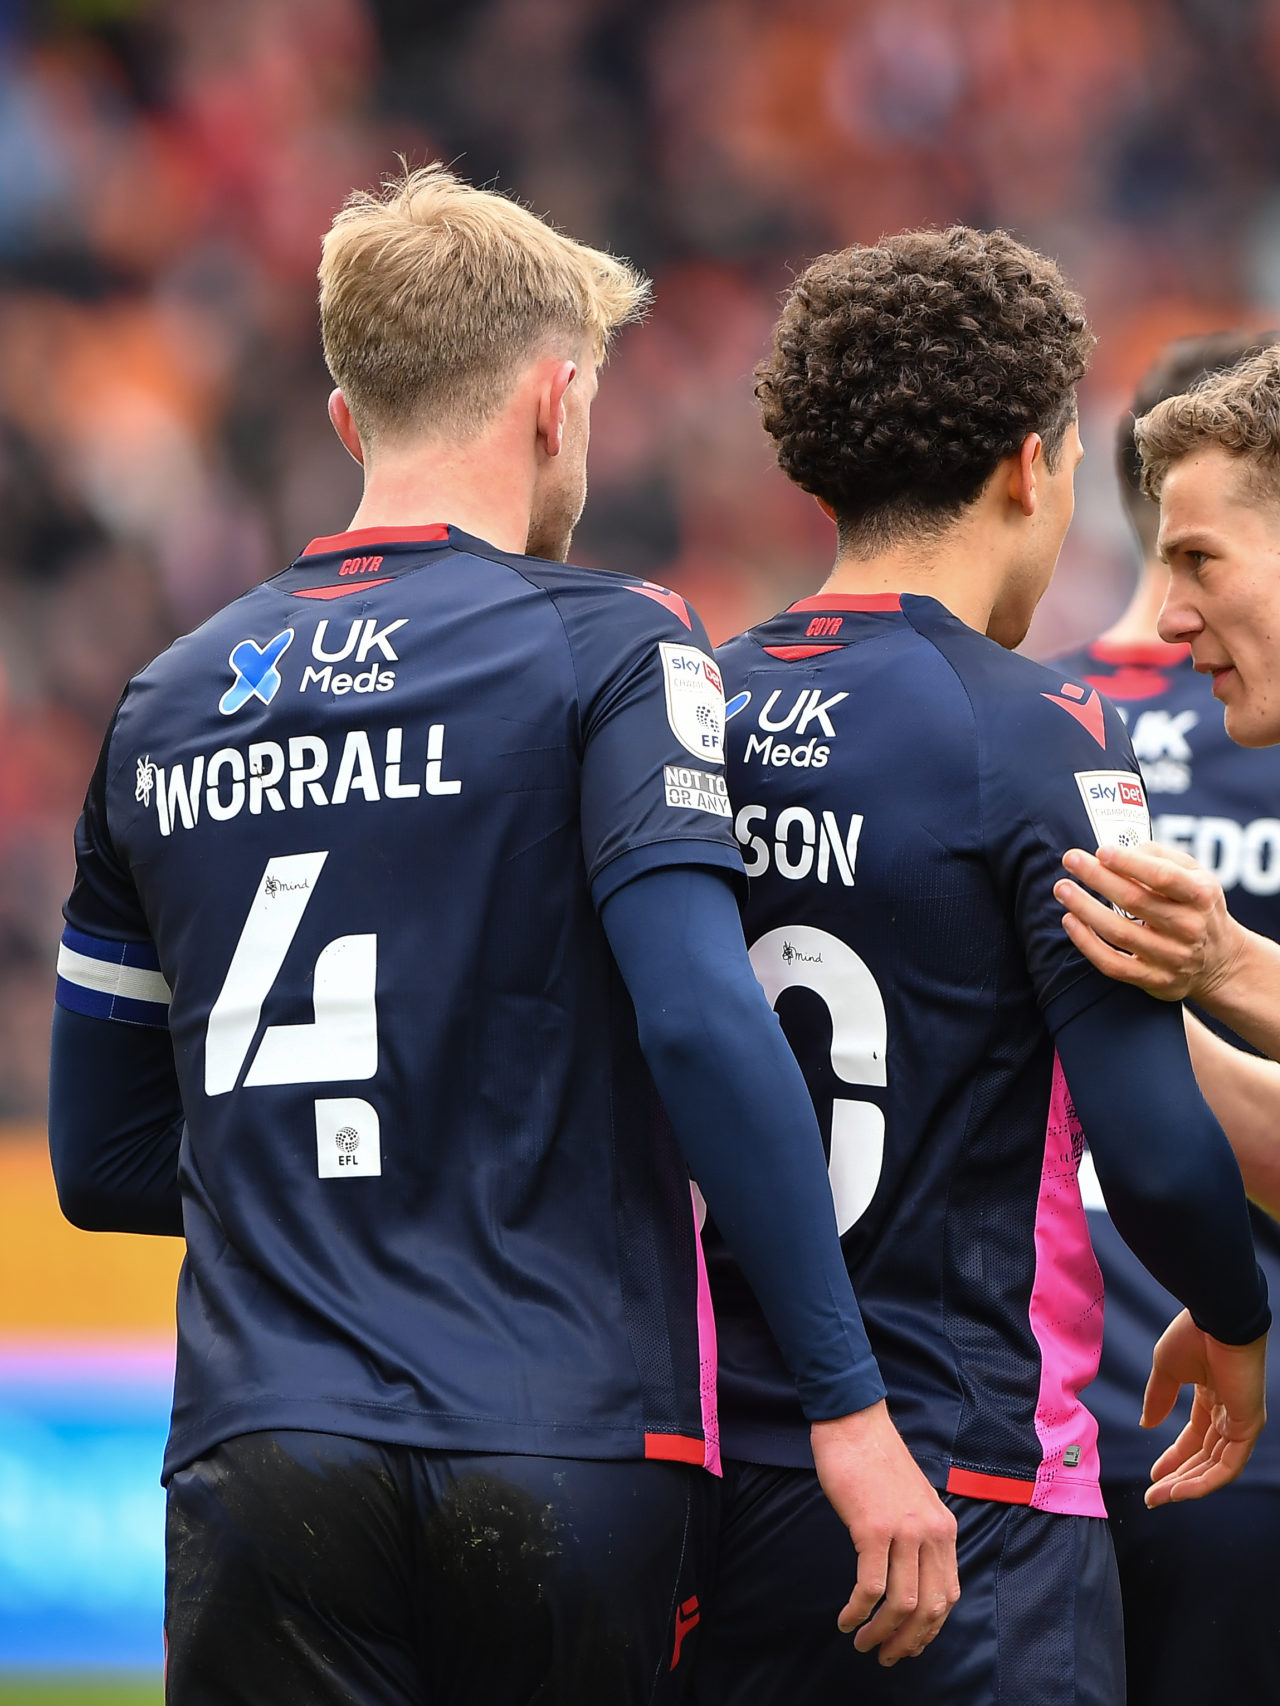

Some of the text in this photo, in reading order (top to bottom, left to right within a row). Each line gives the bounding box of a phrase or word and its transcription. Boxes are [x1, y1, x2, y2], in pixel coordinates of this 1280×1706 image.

[338, 555, 384, 577] COYR
[311, 617, 410, 663] UK
[804, 616, 844, 637] COYR
[299, 662, 397, 696] Meds
[671, 656, 700, 676] sky
[757, 688, 851, 738] UK
[701, 733, 720, 748] EF
[743, 733, 831, 769] Meds
[155, 724, 462, 837] WORRALL
[665, 766, 729, 797] NOT TO
[1089, 783, 1143, 803] sky bet
[669, 788, 728, 814] OR ANY
[204, 850, 382, 1179] 4
[338, 1154, 359, 1166] EFL
